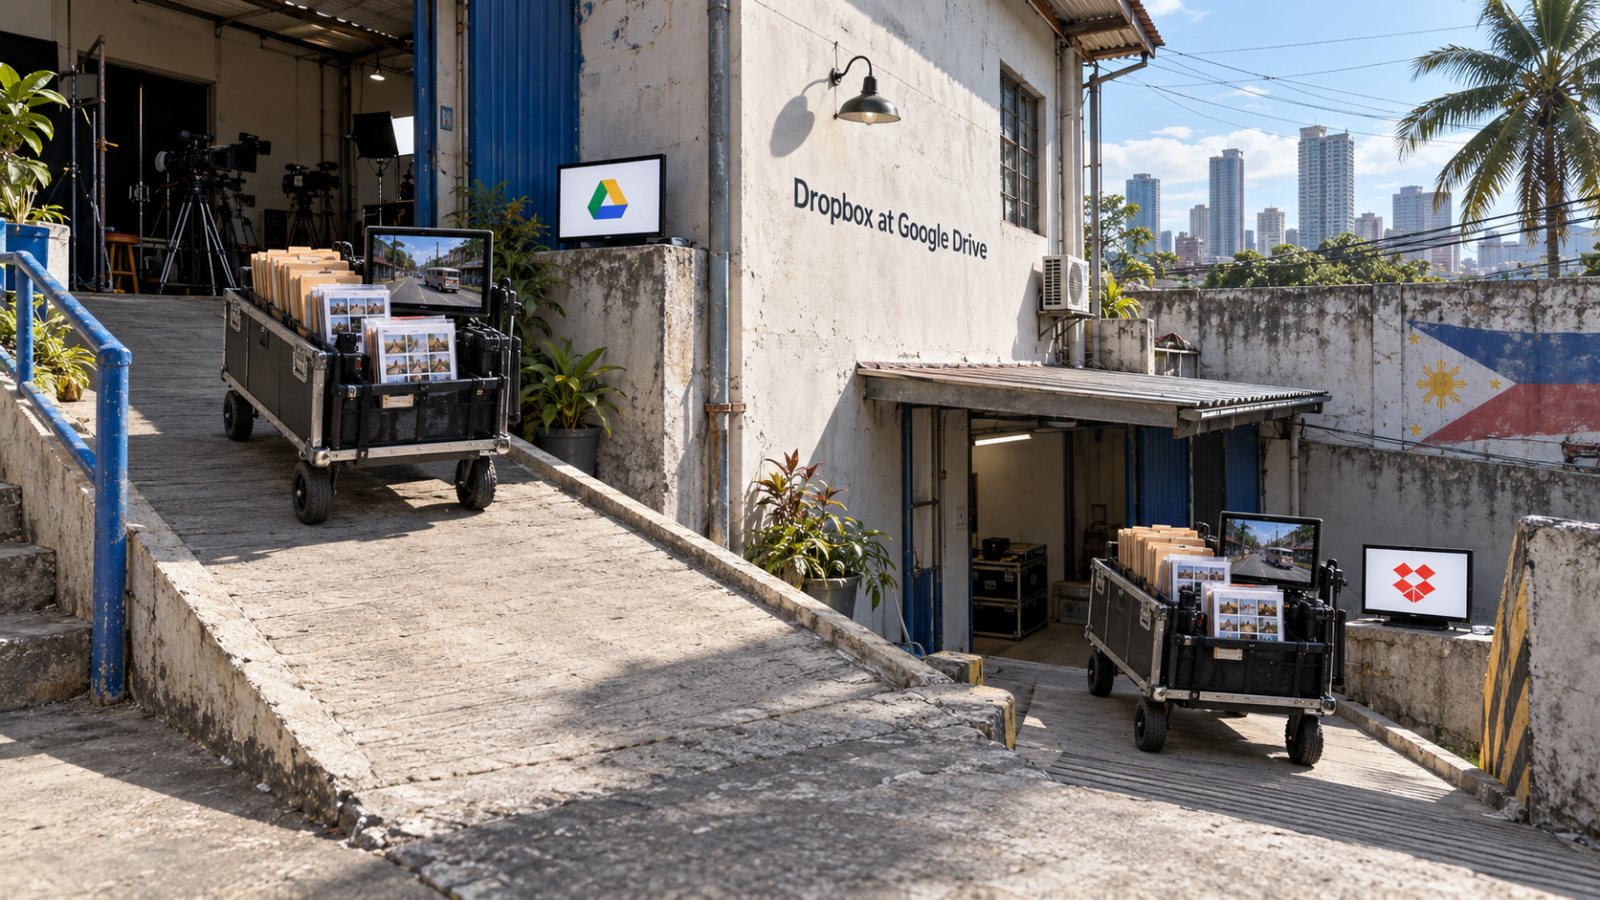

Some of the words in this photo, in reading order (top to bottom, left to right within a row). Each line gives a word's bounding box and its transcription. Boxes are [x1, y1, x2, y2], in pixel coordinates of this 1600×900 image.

[794, 177, 873, 229] Dropbox
[878, 210, 894, 234] at
[898, 212, 949, 252] Google
[953, 229, 987, 260] Drive
